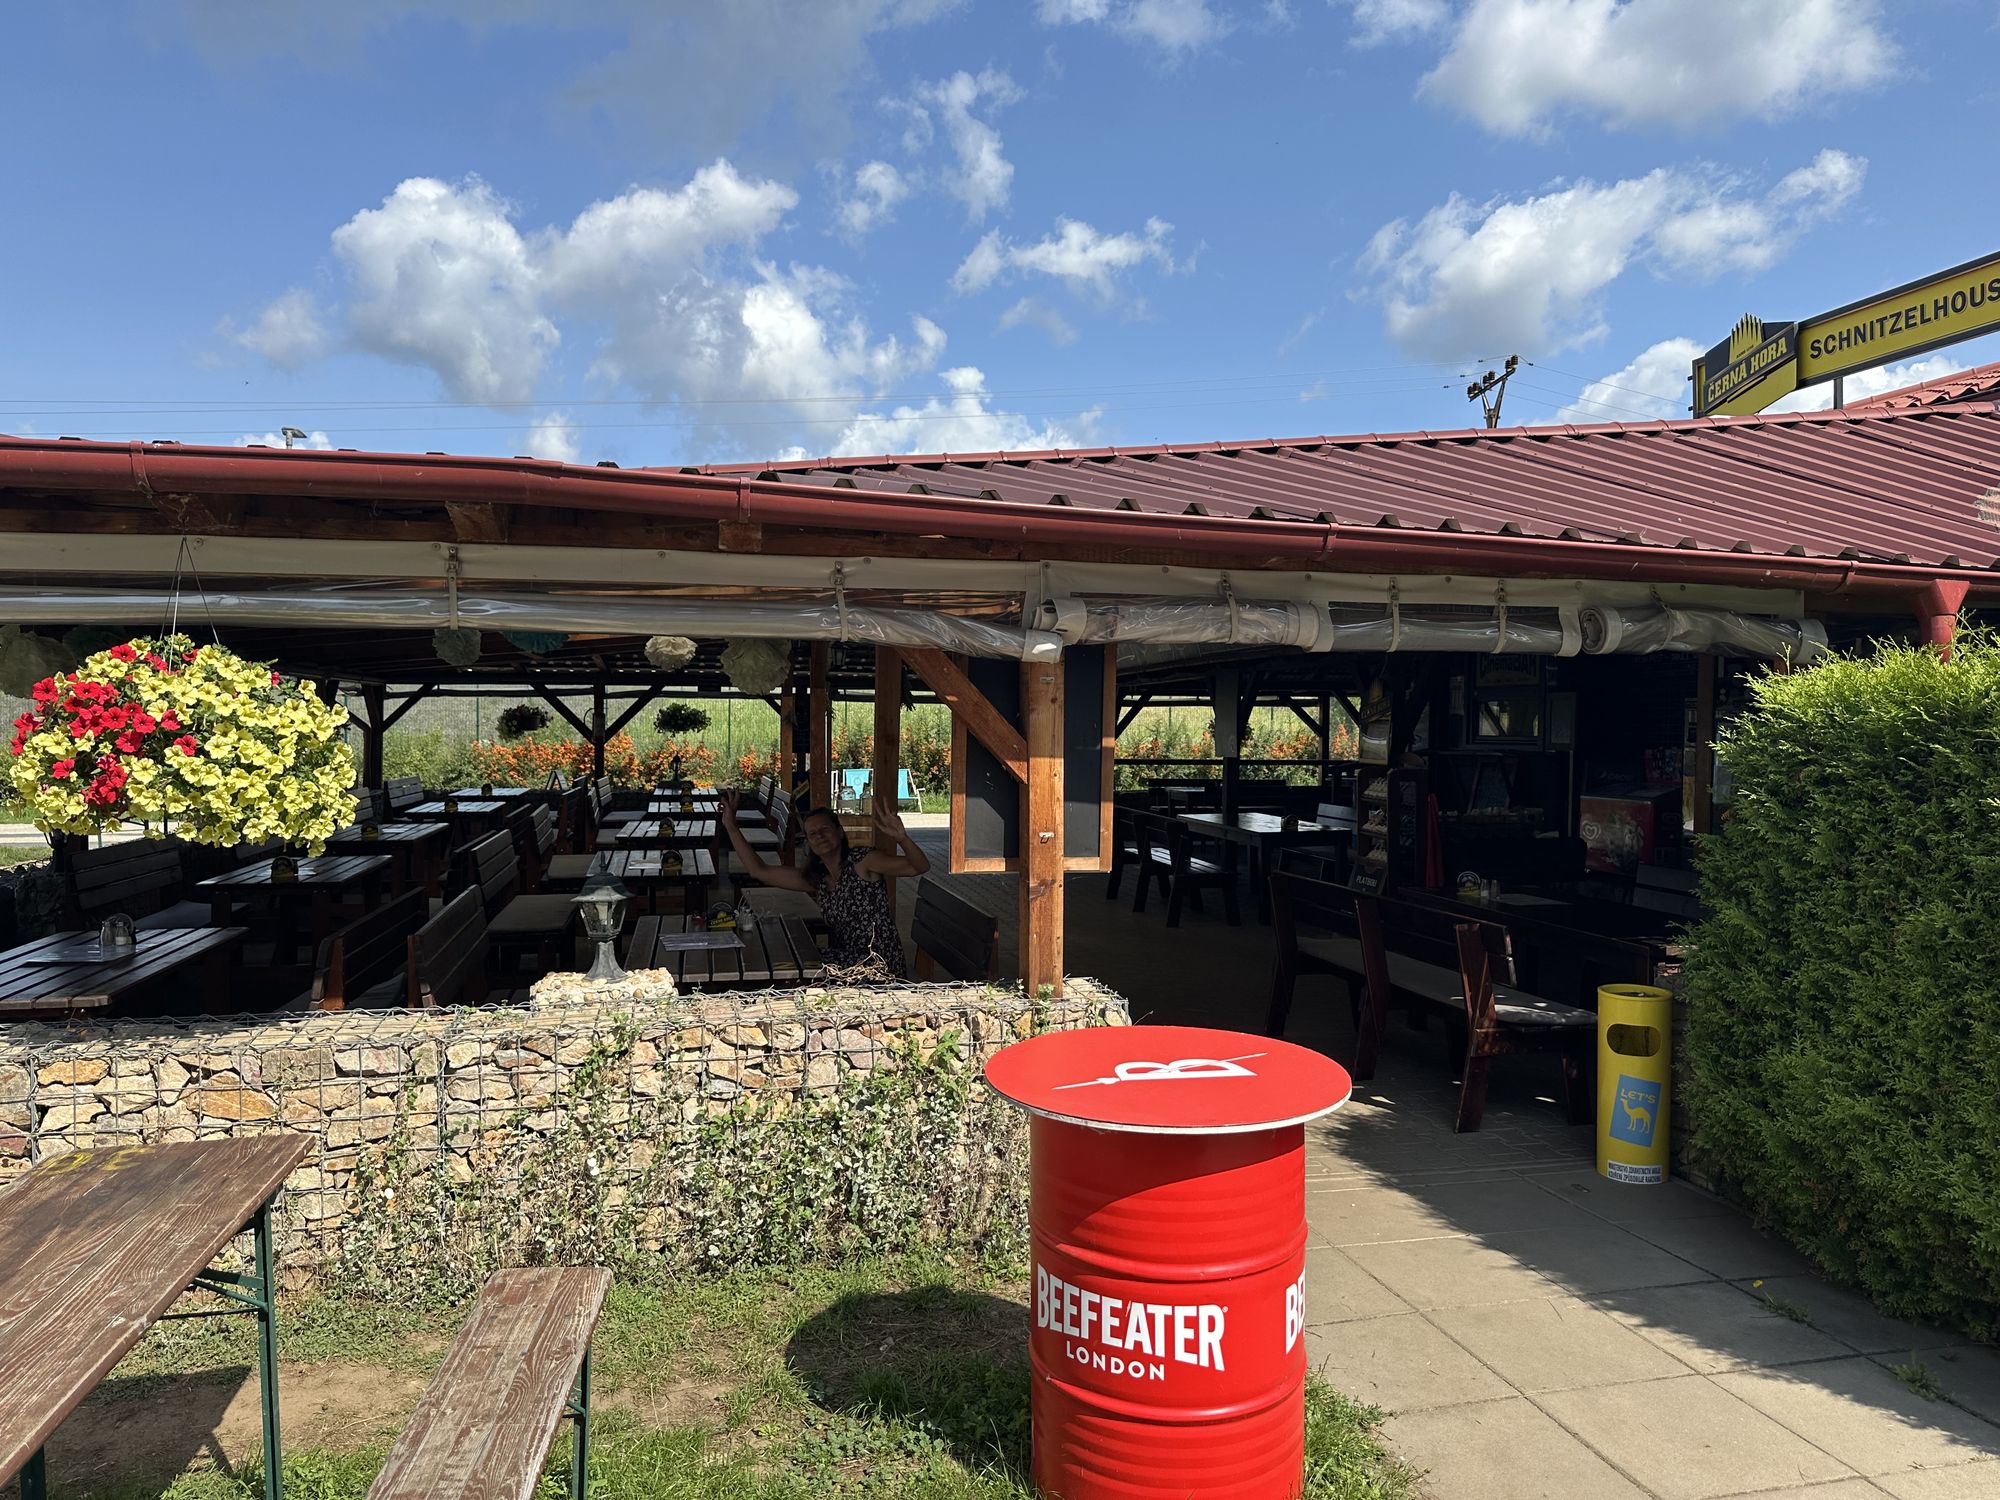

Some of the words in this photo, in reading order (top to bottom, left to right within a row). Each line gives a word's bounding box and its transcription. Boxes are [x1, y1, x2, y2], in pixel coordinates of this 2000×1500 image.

[1810, 278, 2000, 360] SCHNITZELHOUS
[1708, 360, 1747, 402] ČERNÁ
[1750, 337, 1787, 374] HORA
[1621, 1088, 1656, 1104] LET'S
[1037, 1263, 1226, 1371] BEEFEATER
[1286, 1265, 1306, 1355] BE
[1066, 1341, 1165, 1381] LONDON
